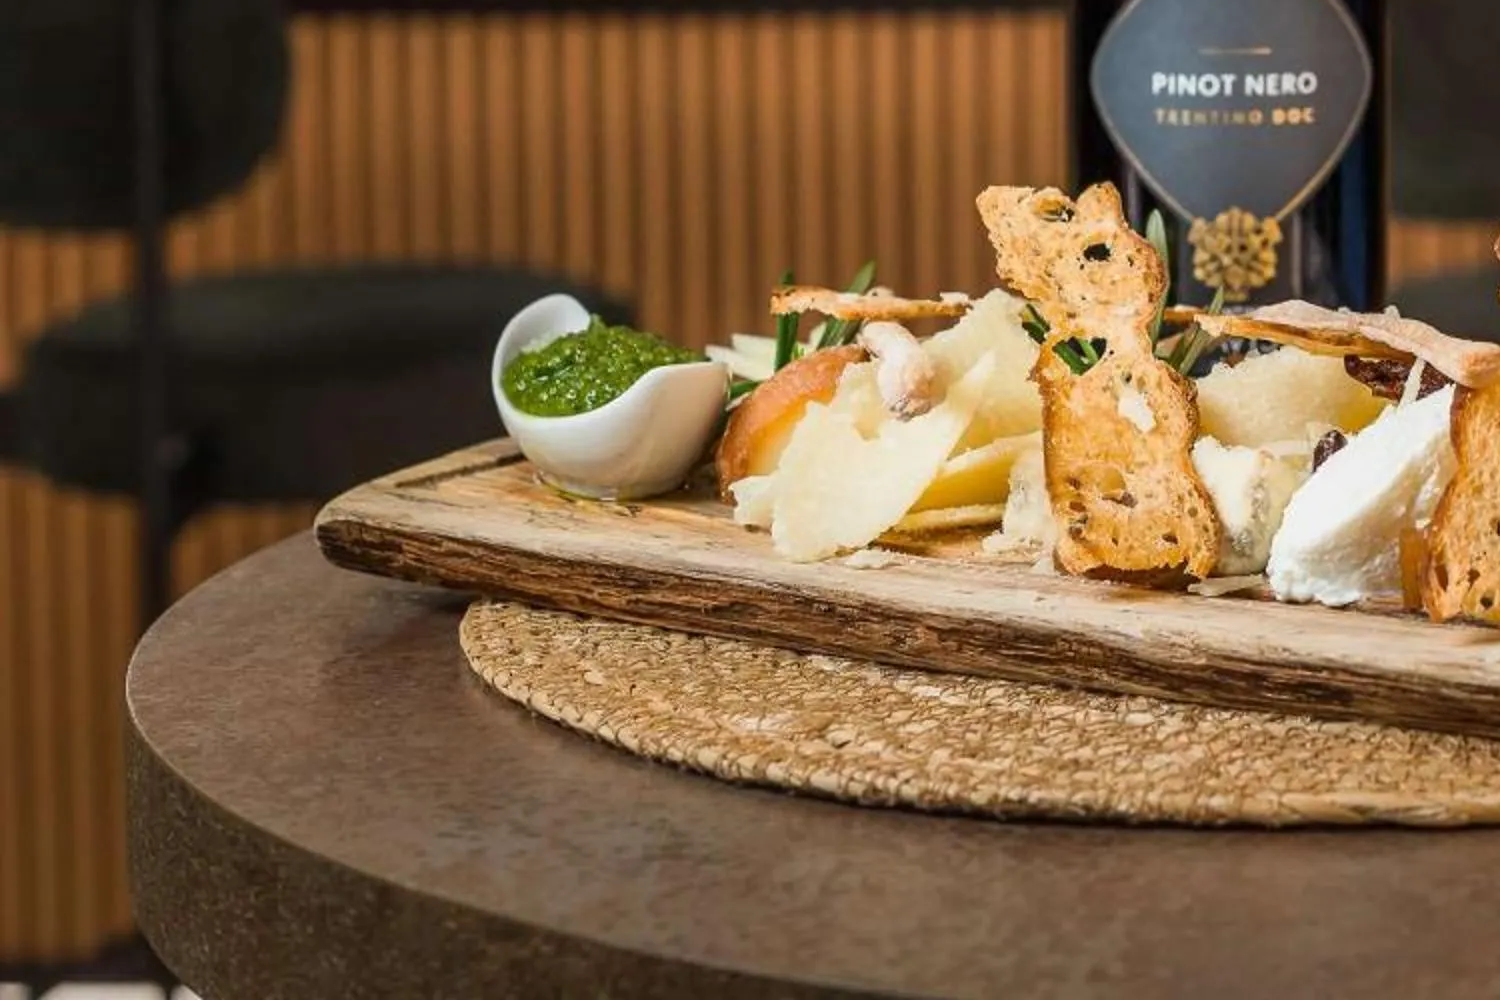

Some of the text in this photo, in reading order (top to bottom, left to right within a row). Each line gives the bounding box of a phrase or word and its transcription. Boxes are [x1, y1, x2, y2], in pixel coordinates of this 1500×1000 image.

[1152, 71, 1318, 97] PINOT NERO
[1154, 107, 1316, 126] TRENTINO DOC
